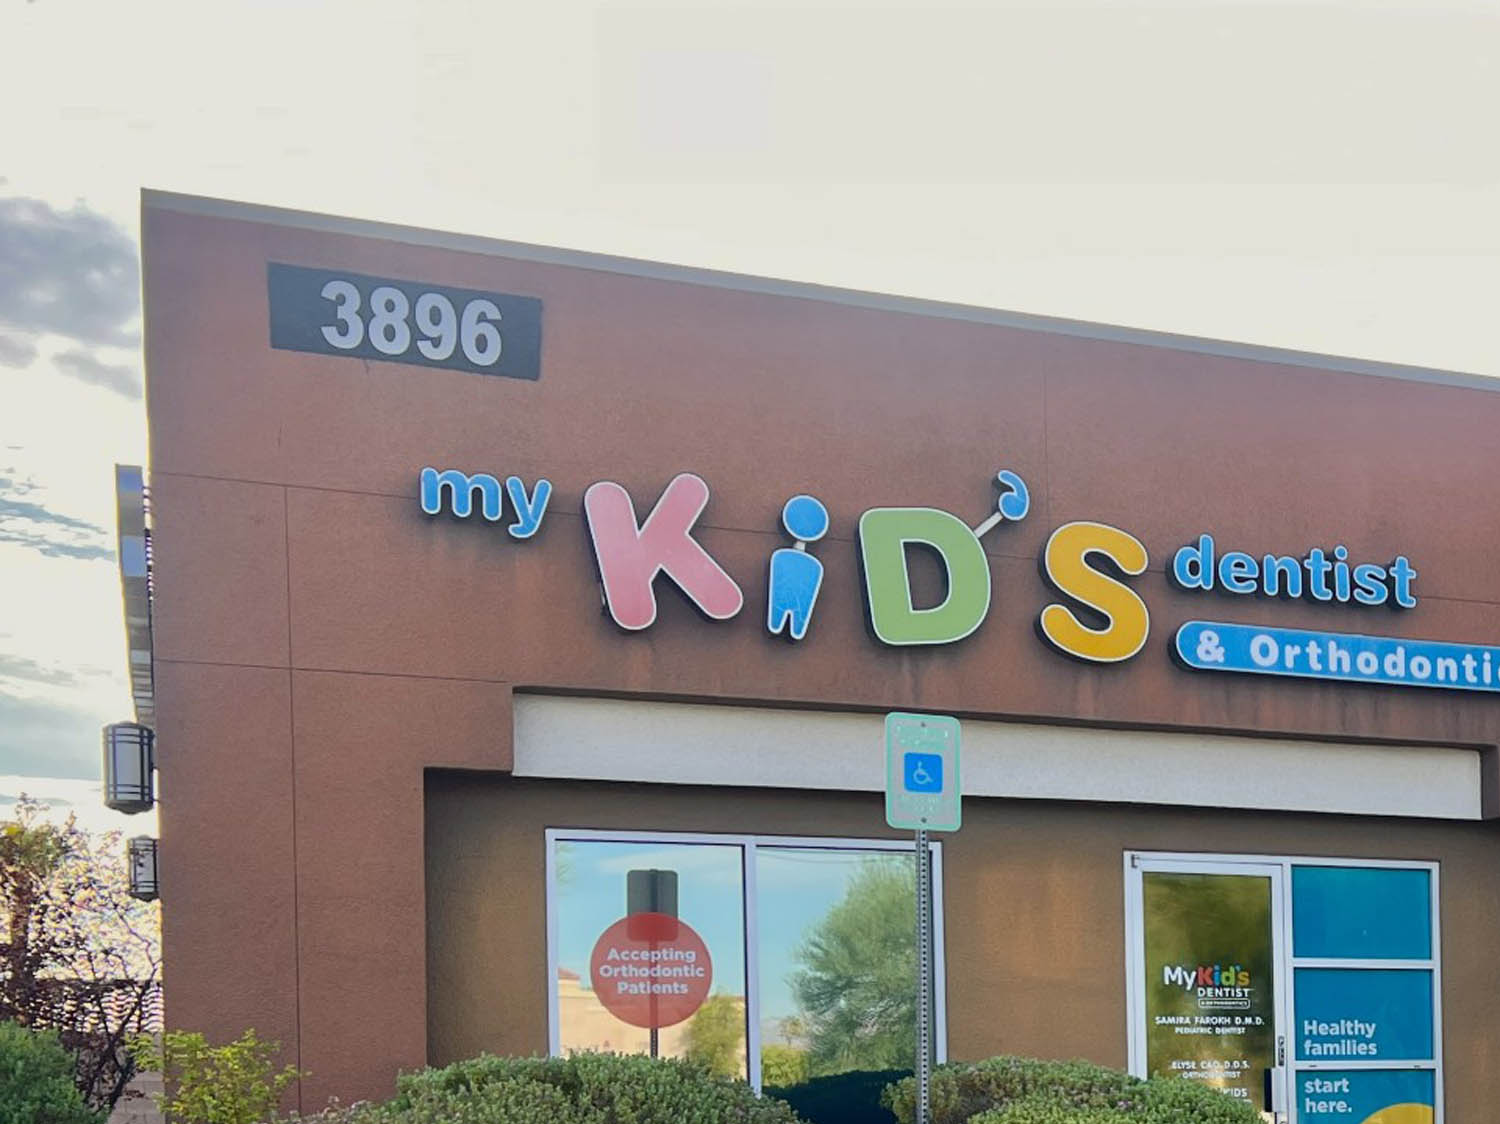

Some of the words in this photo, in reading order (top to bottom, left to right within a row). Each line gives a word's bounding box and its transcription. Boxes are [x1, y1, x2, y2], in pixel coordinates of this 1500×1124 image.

[320, 280, 502, 367] 3896
[419, 466, 553, 539] my
[1172, 534, 1417, 609] dentist
[1196, 630, 1225, 664] &
[607, 948, 697, 963] Accepting
[600, 964, 705, 978] Orthodontic
[617, 981, 689, 995] Patients
[1197, 988, 1250, 998] DENTIST
[1155, 1015, 1192, 1025] SAMIRA
[1304, 1019, 1376, 1039] Healthy
[1304, 1039, 1378, 1056] families
[1304, 1078, 1350, 1094] start
[1305, 1097, 1353, 1113] here.
